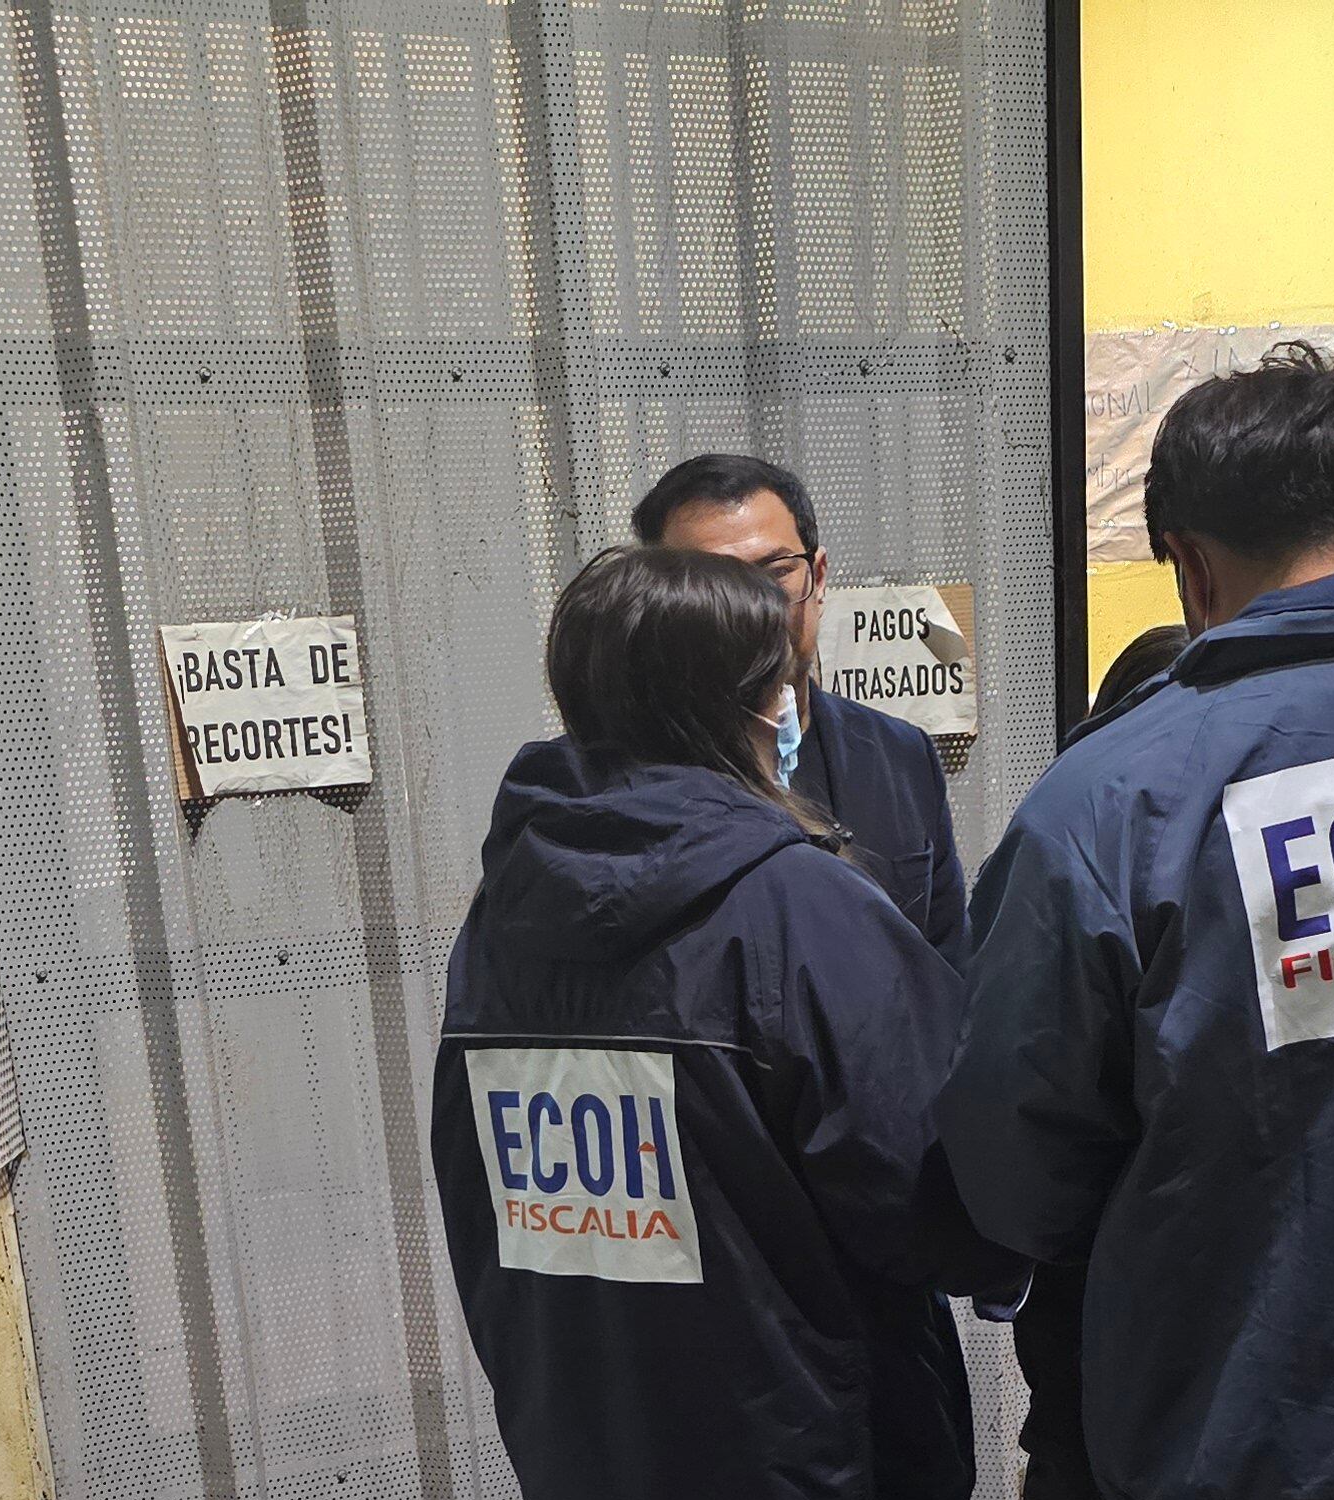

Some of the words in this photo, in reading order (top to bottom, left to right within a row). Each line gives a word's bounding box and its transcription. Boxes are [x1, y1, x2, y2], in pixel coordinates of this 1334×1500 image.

[854, 607, 930, 643] PAGOS
[177, 647, 286, 704] ¡BASTA
[309, 643, 350, 684] DE
[831, 662, 964, 700] ATRASADOS
[186, 713, 353, 765] RECORTES!
[487, 1090, 676, 1200] ECOH
[506, 1199, 681, 1241] FISCALIA
